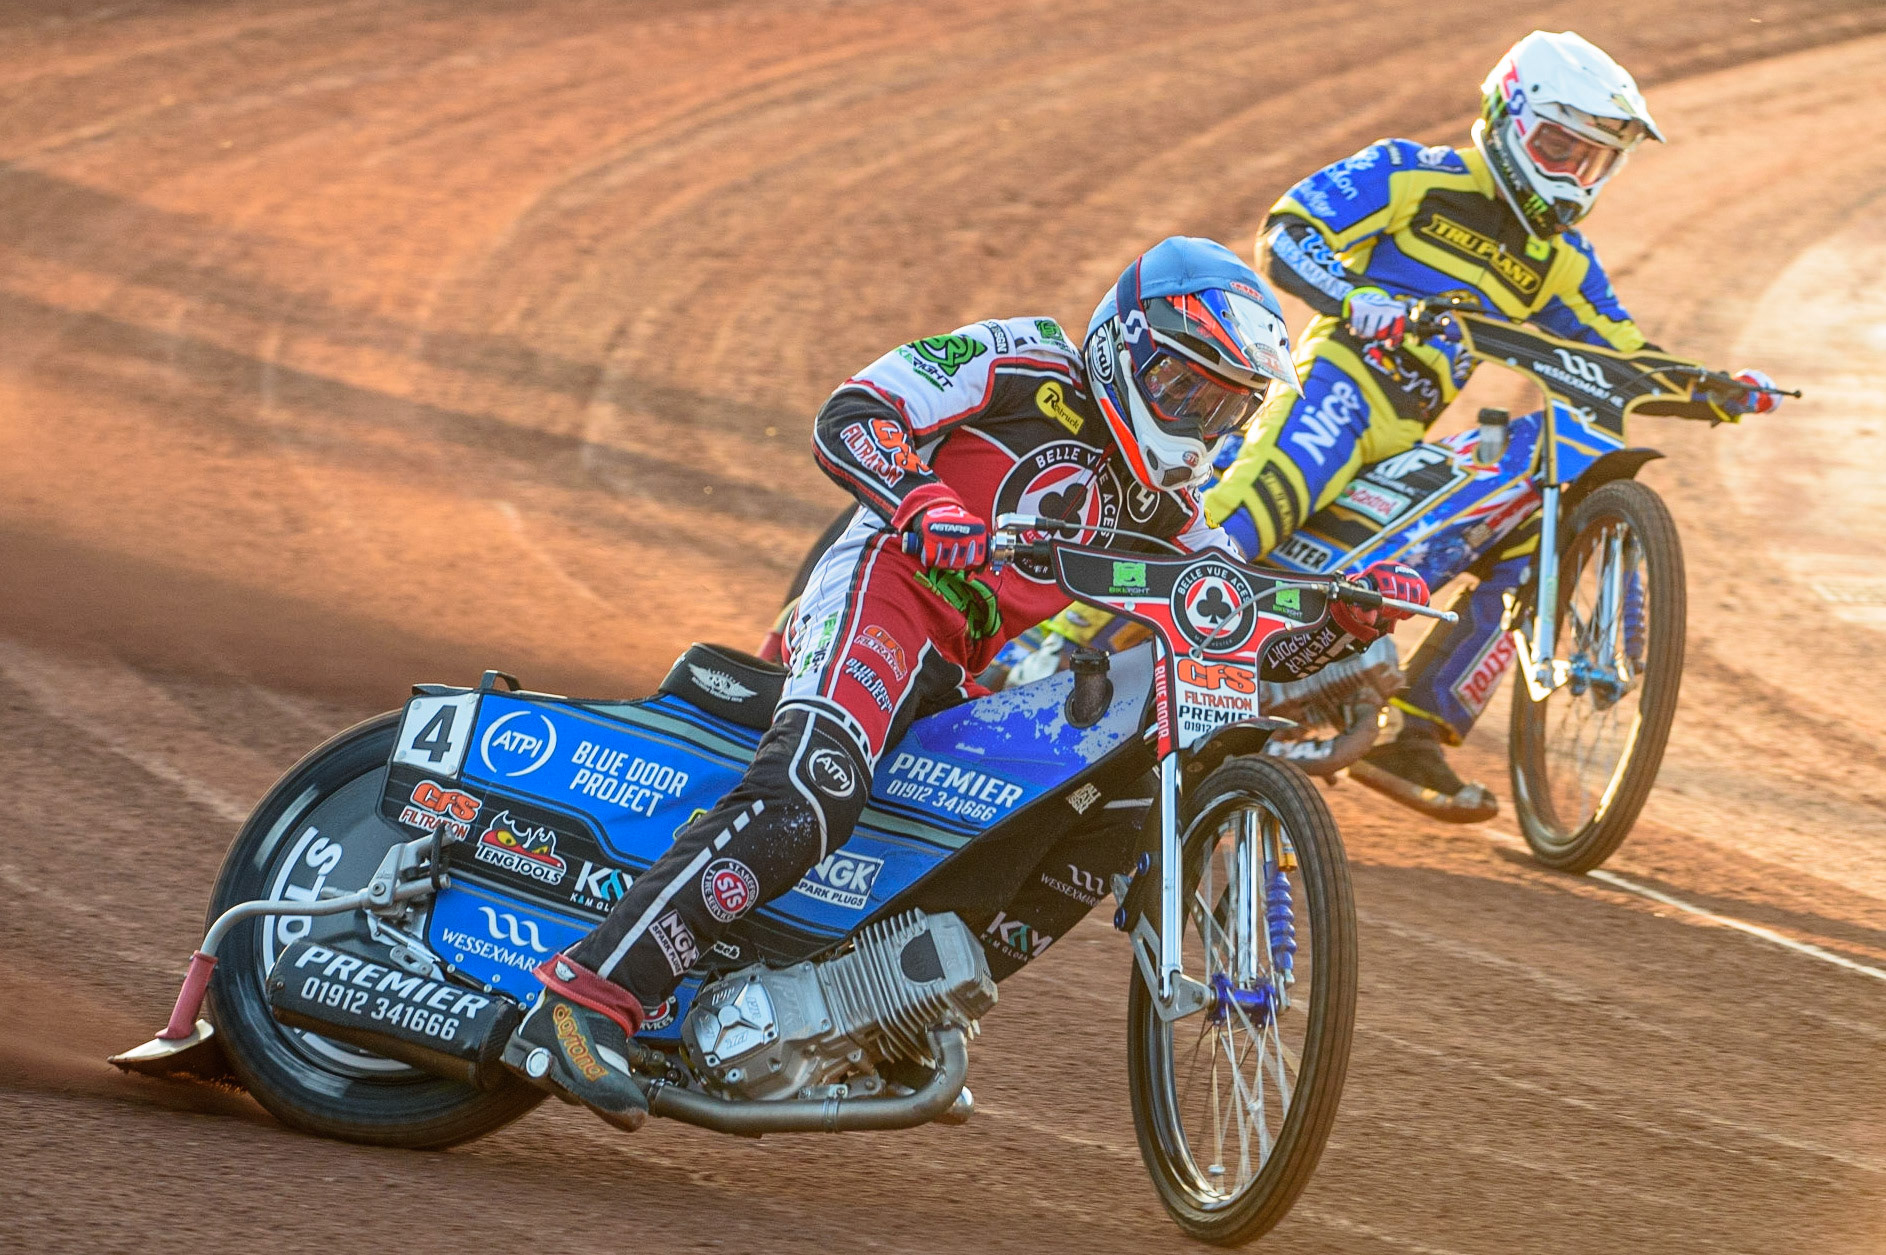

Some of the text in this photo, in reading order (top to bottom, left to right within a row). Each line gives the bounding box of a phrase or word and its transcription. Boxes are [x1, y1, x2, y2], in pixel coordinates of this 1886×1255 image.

[1036, 447, 1080, 469] BELLE
[1177, 568, 1203, 596] BELLE
[1206, 566, 1228, 579] VUE
[1154, 665, 1169, 738] BLUE DOOR
[1179, 705, 1256, 724] PREMIE
[1184, 690, 1252, 711] FILTRATION
[411, 704, 458, 763] 4
[491, 729, 543, 759] ATPI
[571, 740, 690, 797] BLUE DOOR
[815, 753, 852, 791] ATPI
[888, 752, 1024, 809] PREMIER
[569, 769, 664, 818] PROJECT
[887, 779, 997, 823] 01912 341666
[400, 806, 470, 841] FILTRAON
[717, 876, 746, 909] STS
[806, 854, 875, 893] NGK
[1041, 872, 1100, 907] WESSEXMAR
[797, 880, 864, 907] PARK PLUGS
[652, 925, 672, 951] SPARK
[661, 913, 699, 968] NGK
[295, 945, 490, 1019] PREMIER
[300, 976, 459, 1040] 01912 341666
